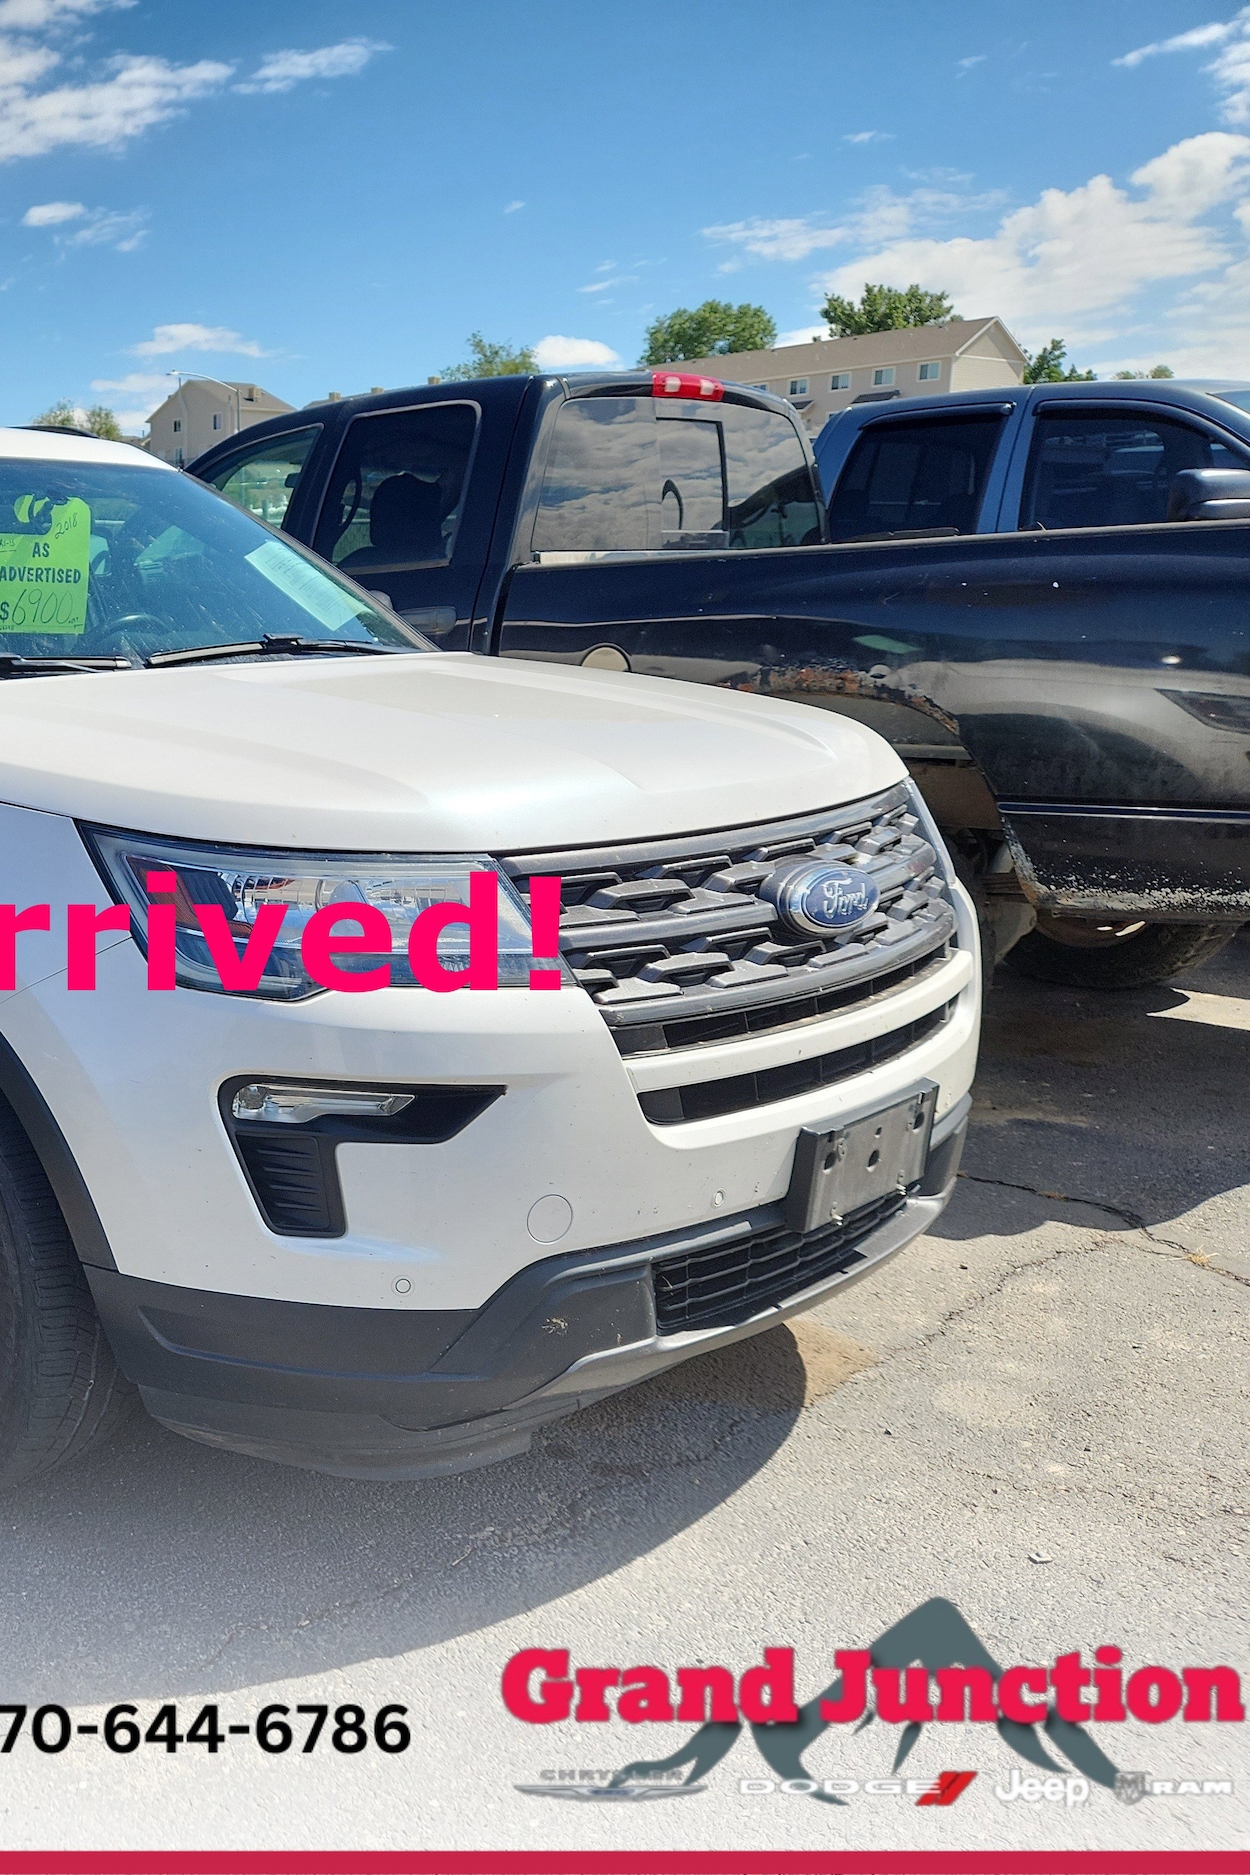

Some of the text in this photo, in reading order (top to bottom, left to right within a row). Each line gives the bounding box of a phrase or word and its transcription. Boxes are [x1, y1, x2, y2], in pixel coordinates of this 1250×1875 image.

[54, 512, 79, 540] 2018
[32, 541, 51, 558] AS
[821, 876, 869, 919] Ford
